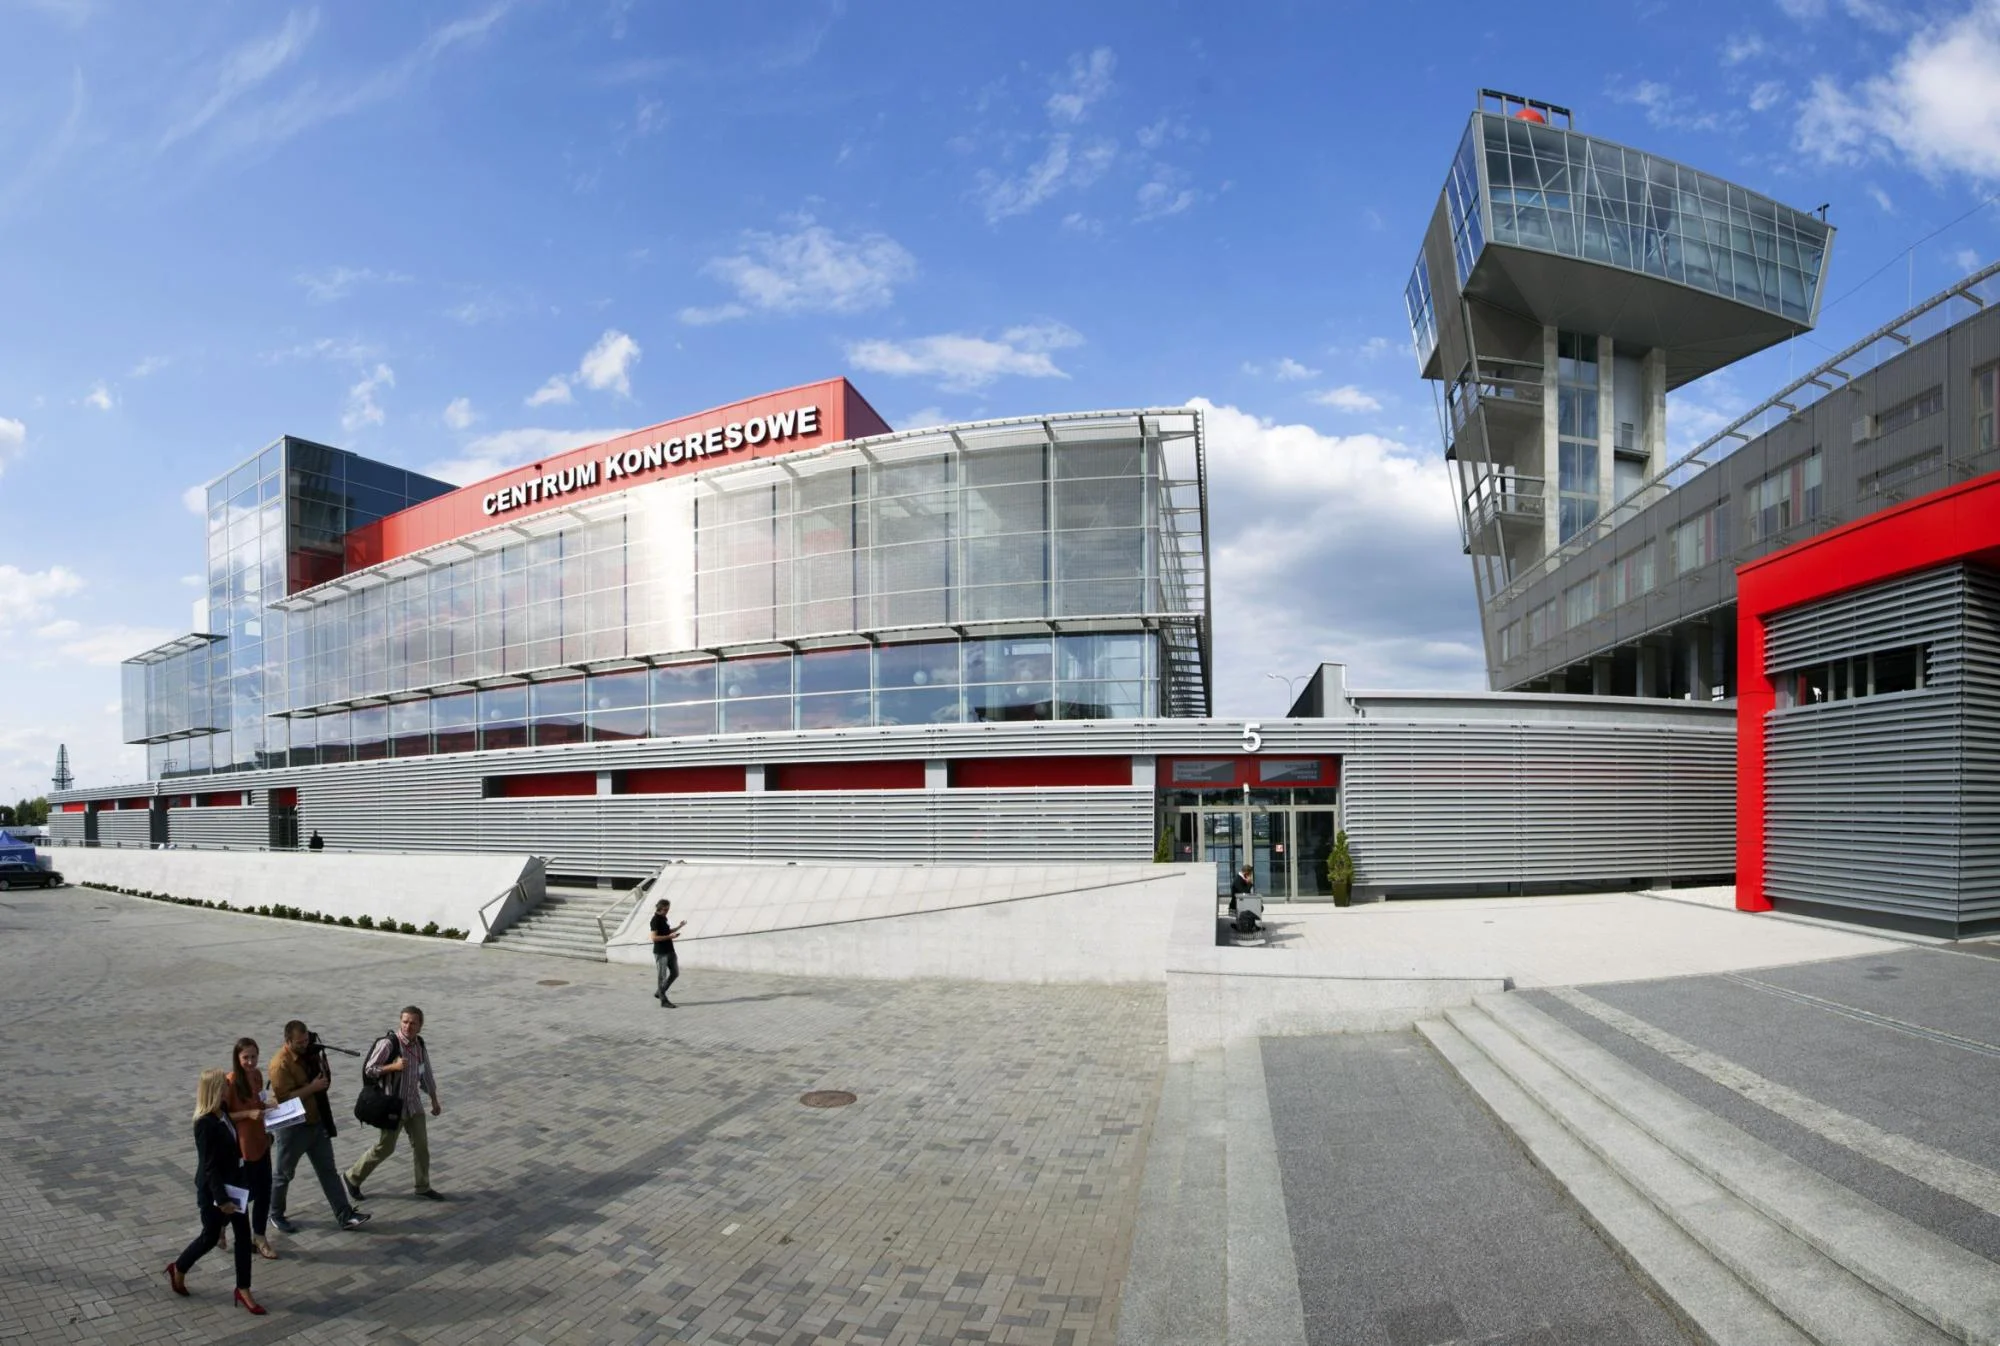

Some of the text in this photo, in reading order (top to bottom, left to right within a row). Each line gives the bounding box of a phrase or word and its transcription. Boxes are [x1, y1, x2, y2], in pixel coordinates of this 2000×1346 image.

[482, 405, 818, 516] CENTRUM KONGRESOWE
[1242, 723, 1262, 752] 5
